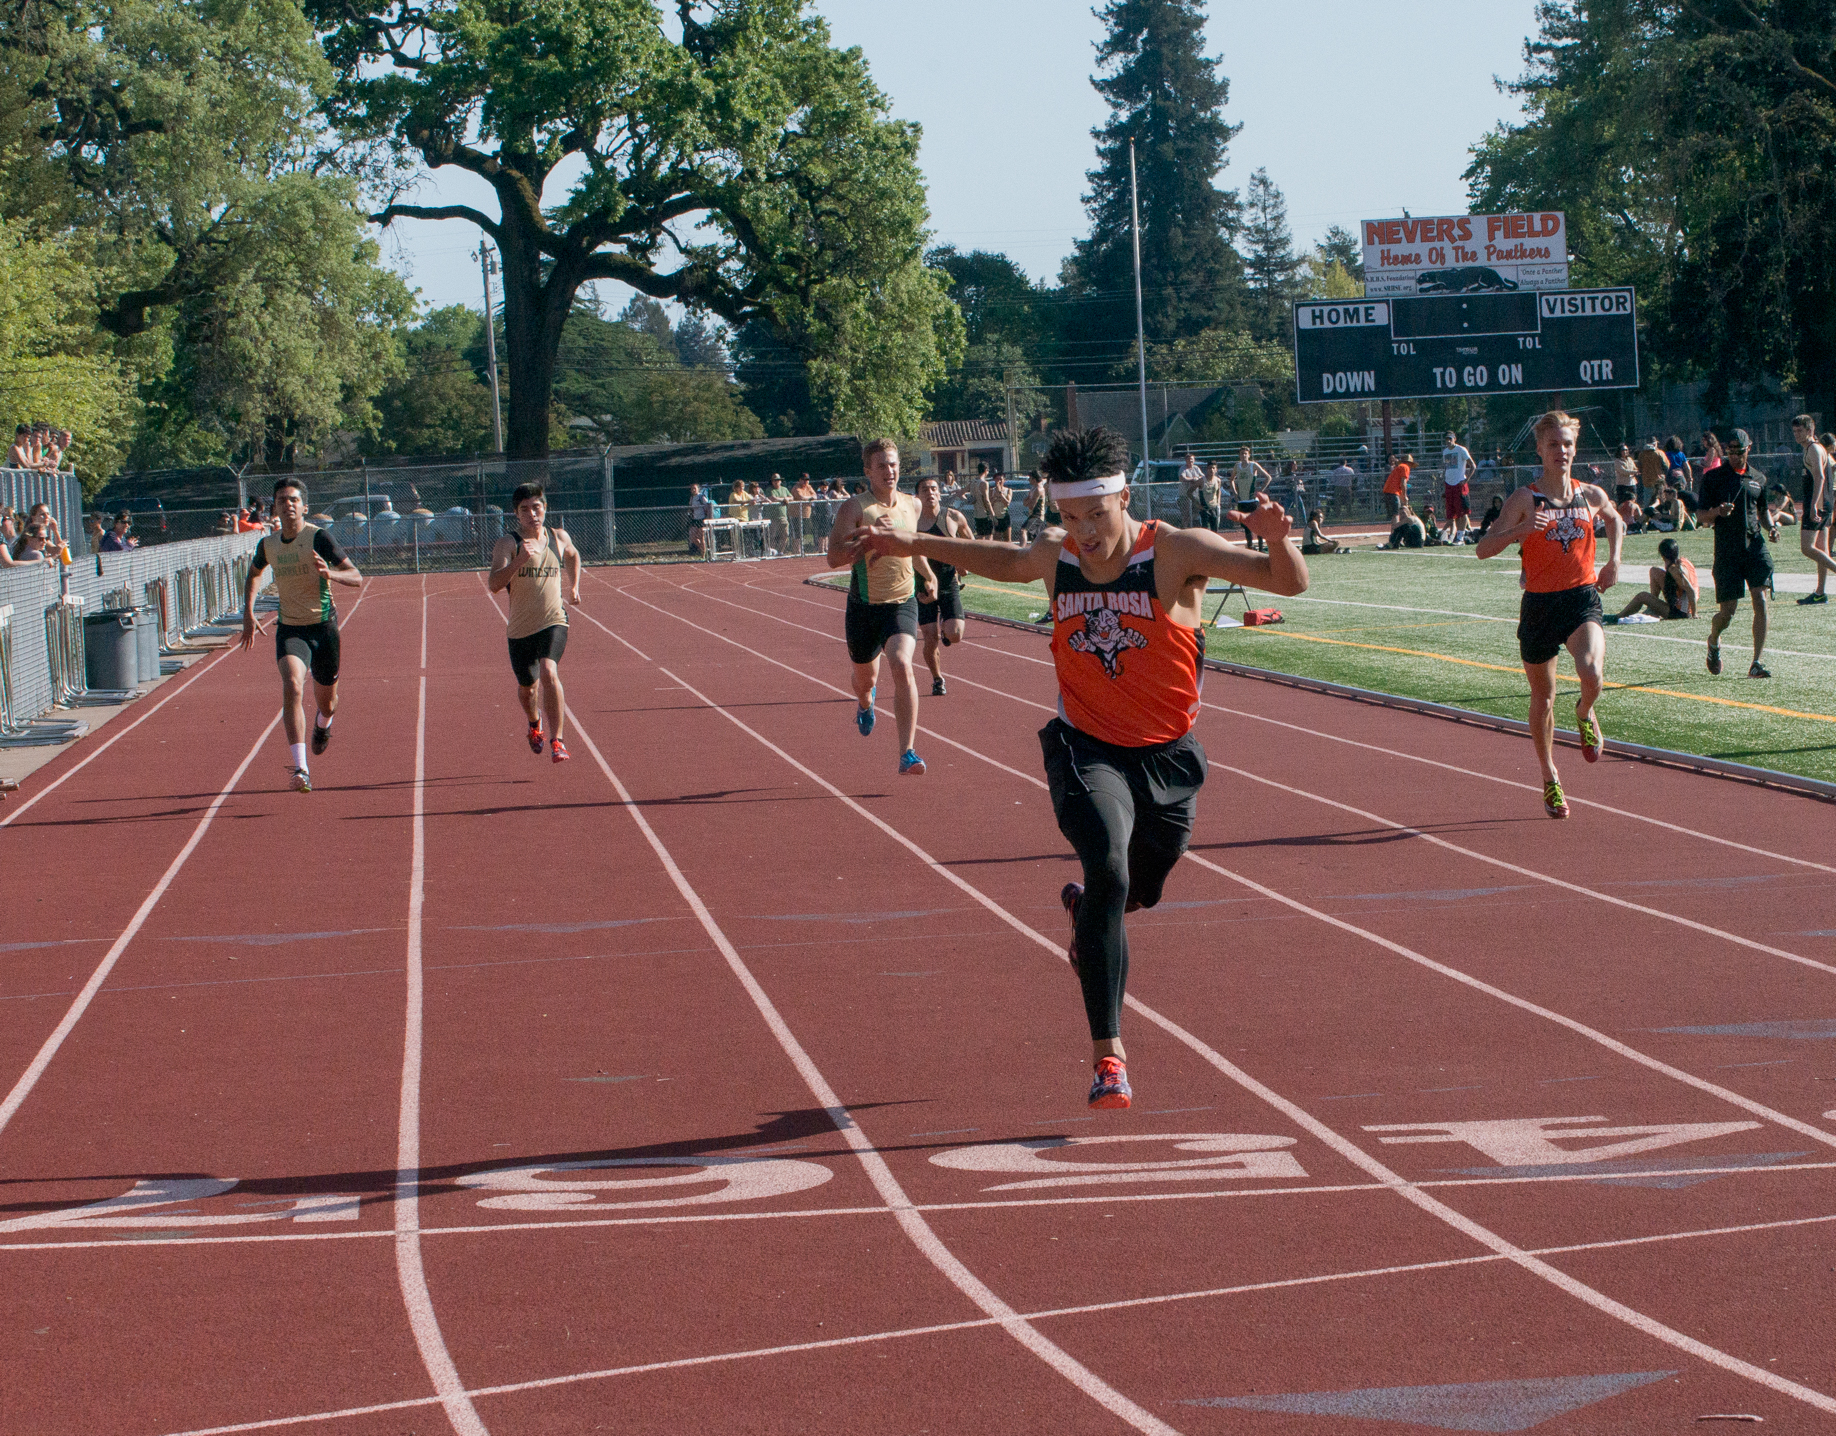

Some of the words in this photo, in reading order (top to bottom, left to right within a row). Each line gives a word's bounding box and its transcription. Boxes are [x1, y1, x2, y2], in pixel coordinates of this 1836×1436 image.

[1366, 218, 1473, 245] NEVERS
[1487, 214, 1560, 243] FIELD
[1380, 248, 1422, 267] Home
[1428, 246, 1446, 266] Of
[1452, 245, 1478, 263] The
[1484, 242, 1551, 262] Panthers
[1311, 305, 1376, 326] HOME
[1545, 295, 1628, 316] VISITOR
[1392, 343, 1416, 355] TOL
[1517, 337, 1542, 350] TOL
[1322, 370, 1375, 394] DOWN
[1433, 367, 1457, 388] TO
[1463, 365, 1488, 387] GO
[1498, 364, 1523, 385] ON
[1580, 360, 1613, 385] QTR
[1544, 509, 1565, 521] ANTA
[1057, 591, 1105, 621] SANTA
[1106, 591, 1155, 620] ROSA
